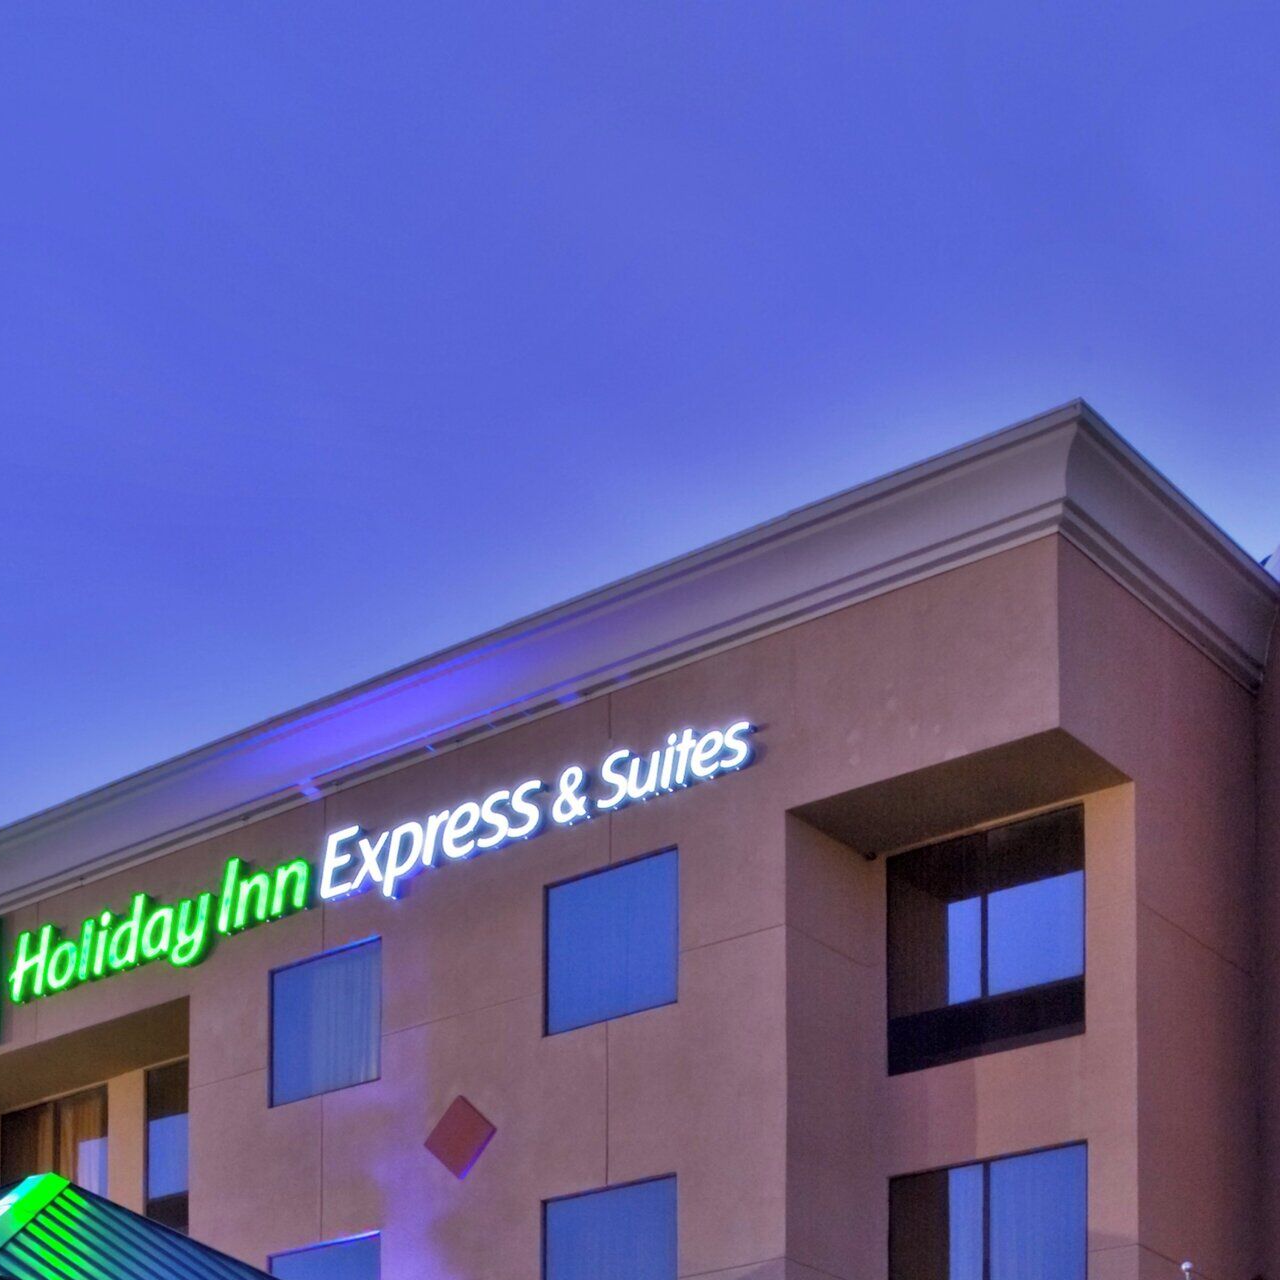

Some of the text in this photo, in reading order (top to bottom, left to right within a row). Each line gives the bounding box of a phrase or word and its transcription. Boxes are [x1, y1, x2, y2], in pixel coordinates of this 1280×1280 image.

[8, 720, 751, 1004] Holiday Inn Express & Suites
